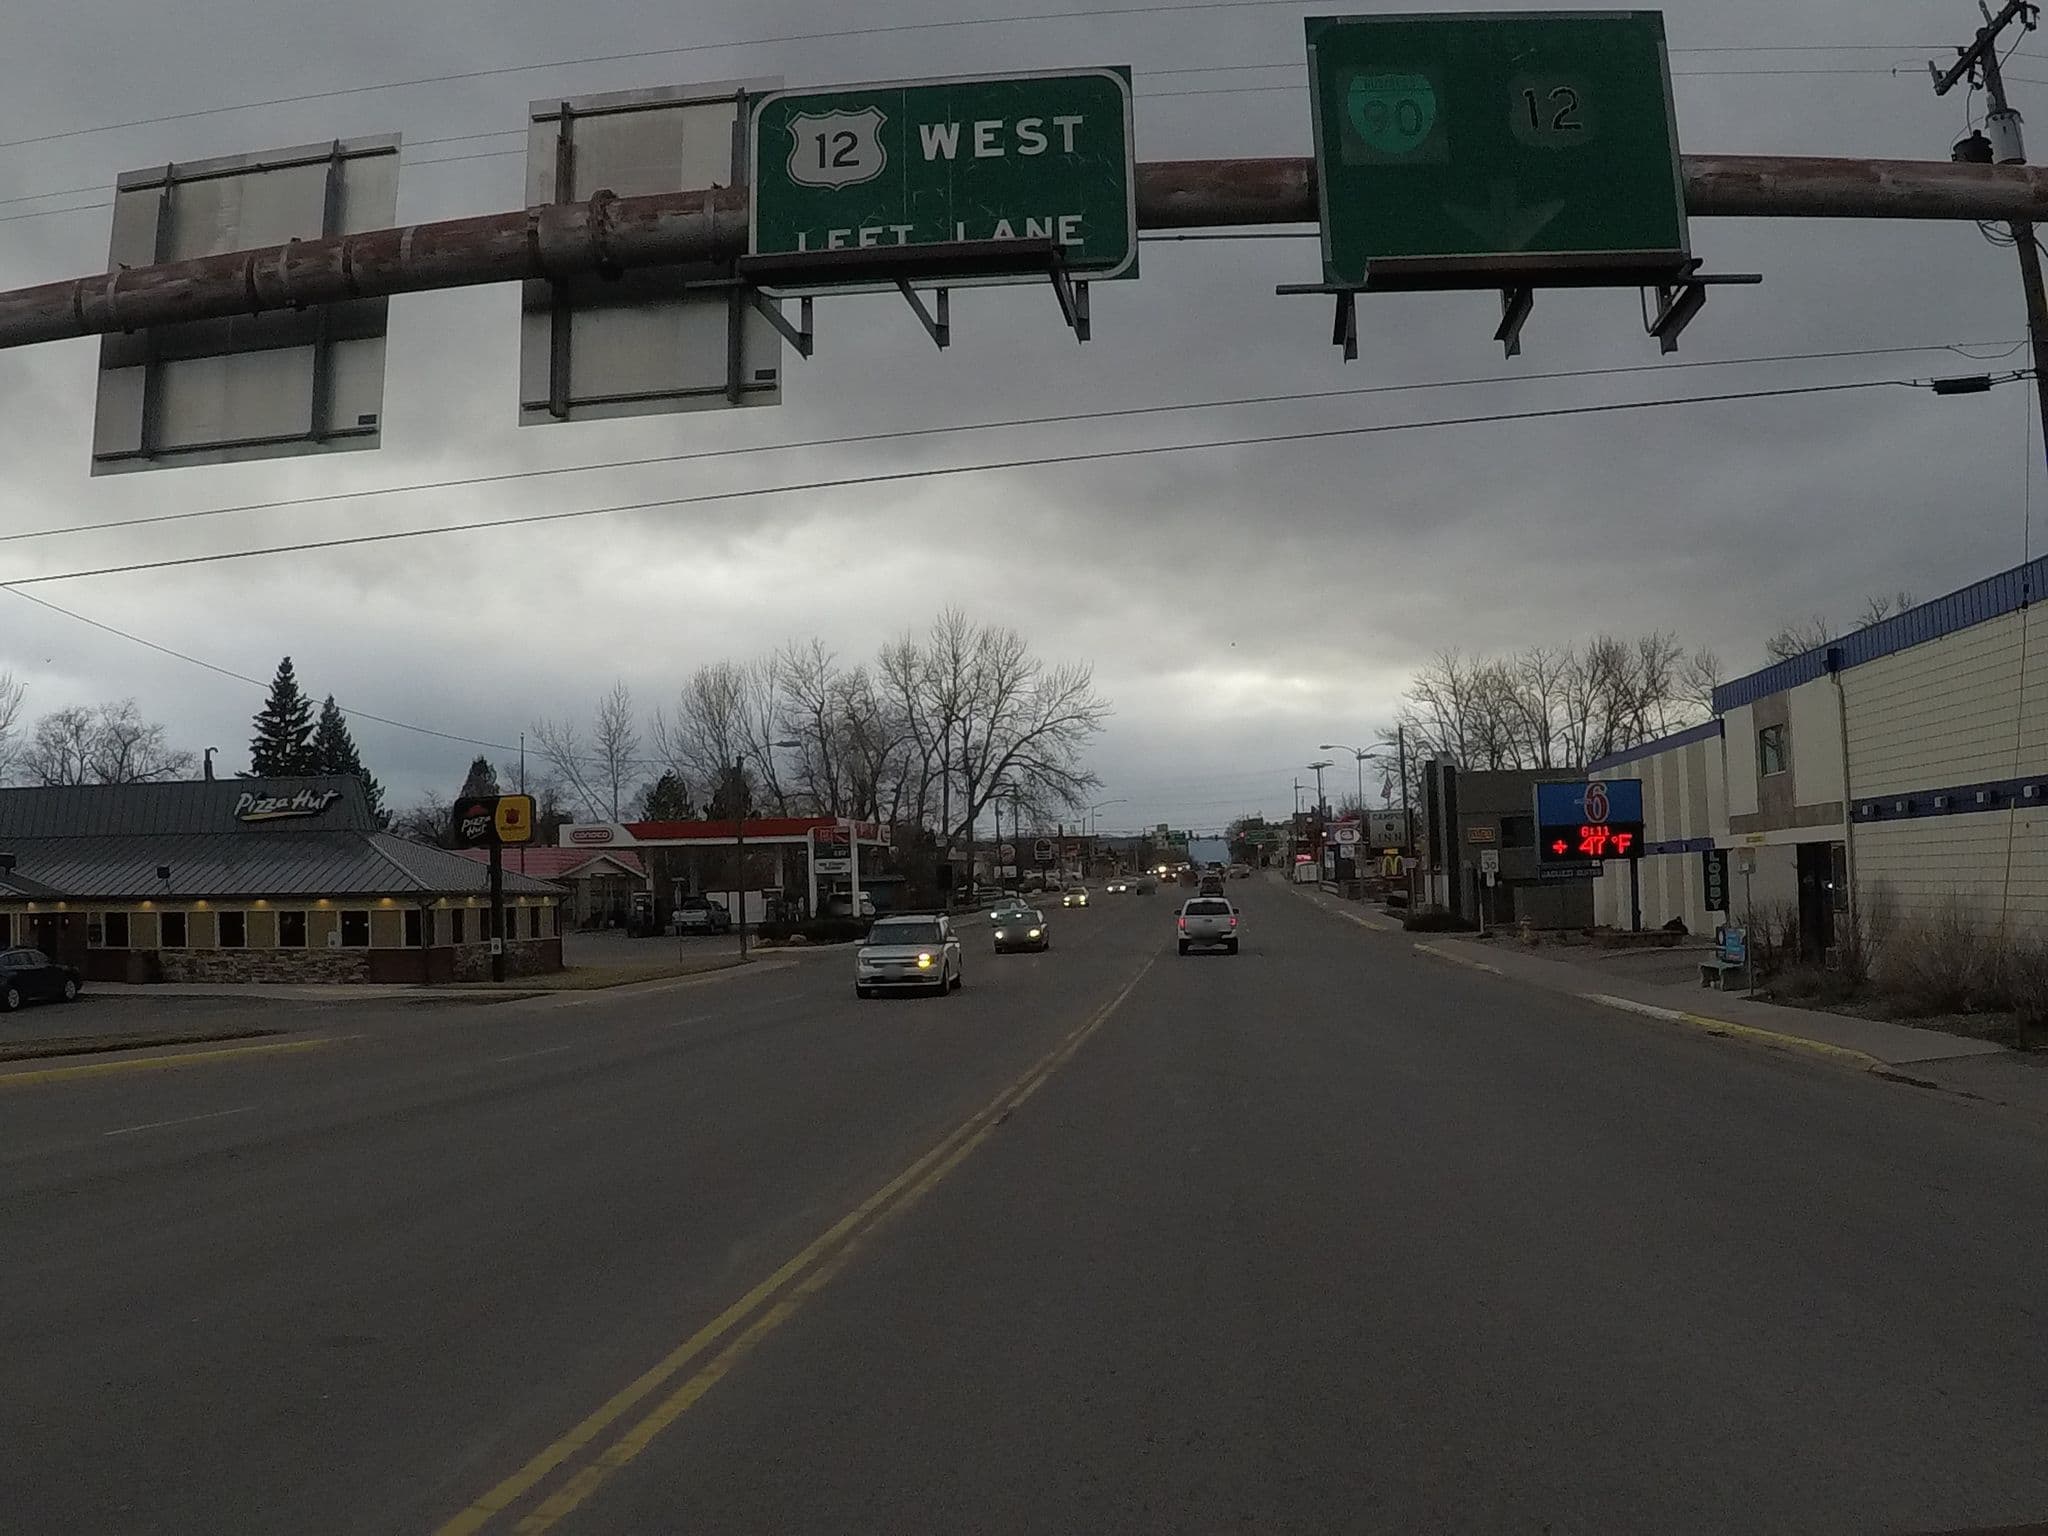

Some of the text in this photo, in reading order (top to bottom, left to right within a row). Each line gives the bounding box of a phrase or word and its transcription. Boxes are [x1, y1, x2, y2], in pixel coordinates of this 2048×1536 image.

[1522, 86, 1582, 130] 12
[815, 131, 859, 169] 12
[919, 115, 1083, 160] WEST
[234, 789, 339, 816] Pizza Hut
[1584, 783, 1610, 823] 6
[1708, 851, 1722, 909] LOBBY
